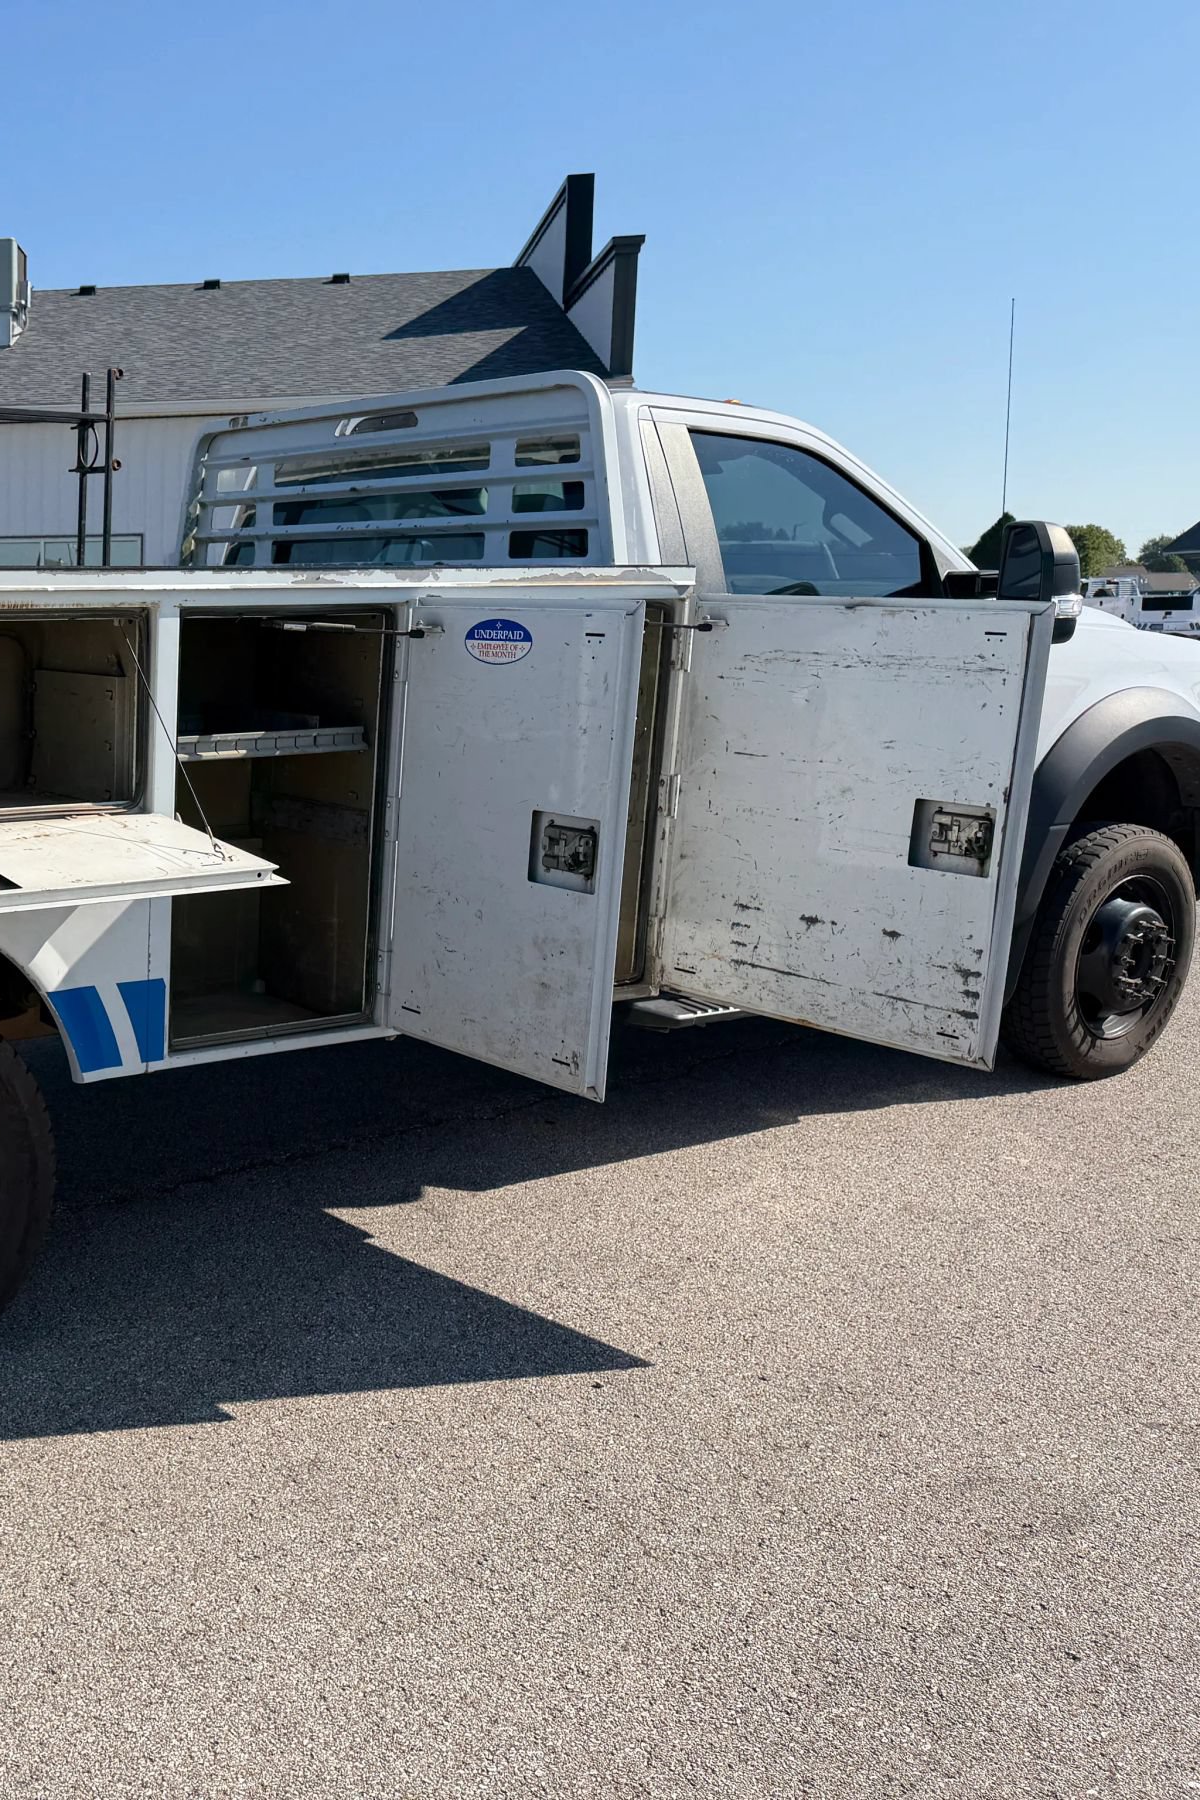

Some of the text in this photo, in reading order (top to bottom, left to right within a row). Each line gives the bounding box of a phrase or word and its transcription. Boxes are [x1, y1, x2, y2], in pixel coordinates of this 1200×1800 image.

[474, 629, 524, 640] UNDERPAID
[477, 642, 509, 651] EMPLOYEE
[479, 650, 517, 659] THE MONTH
